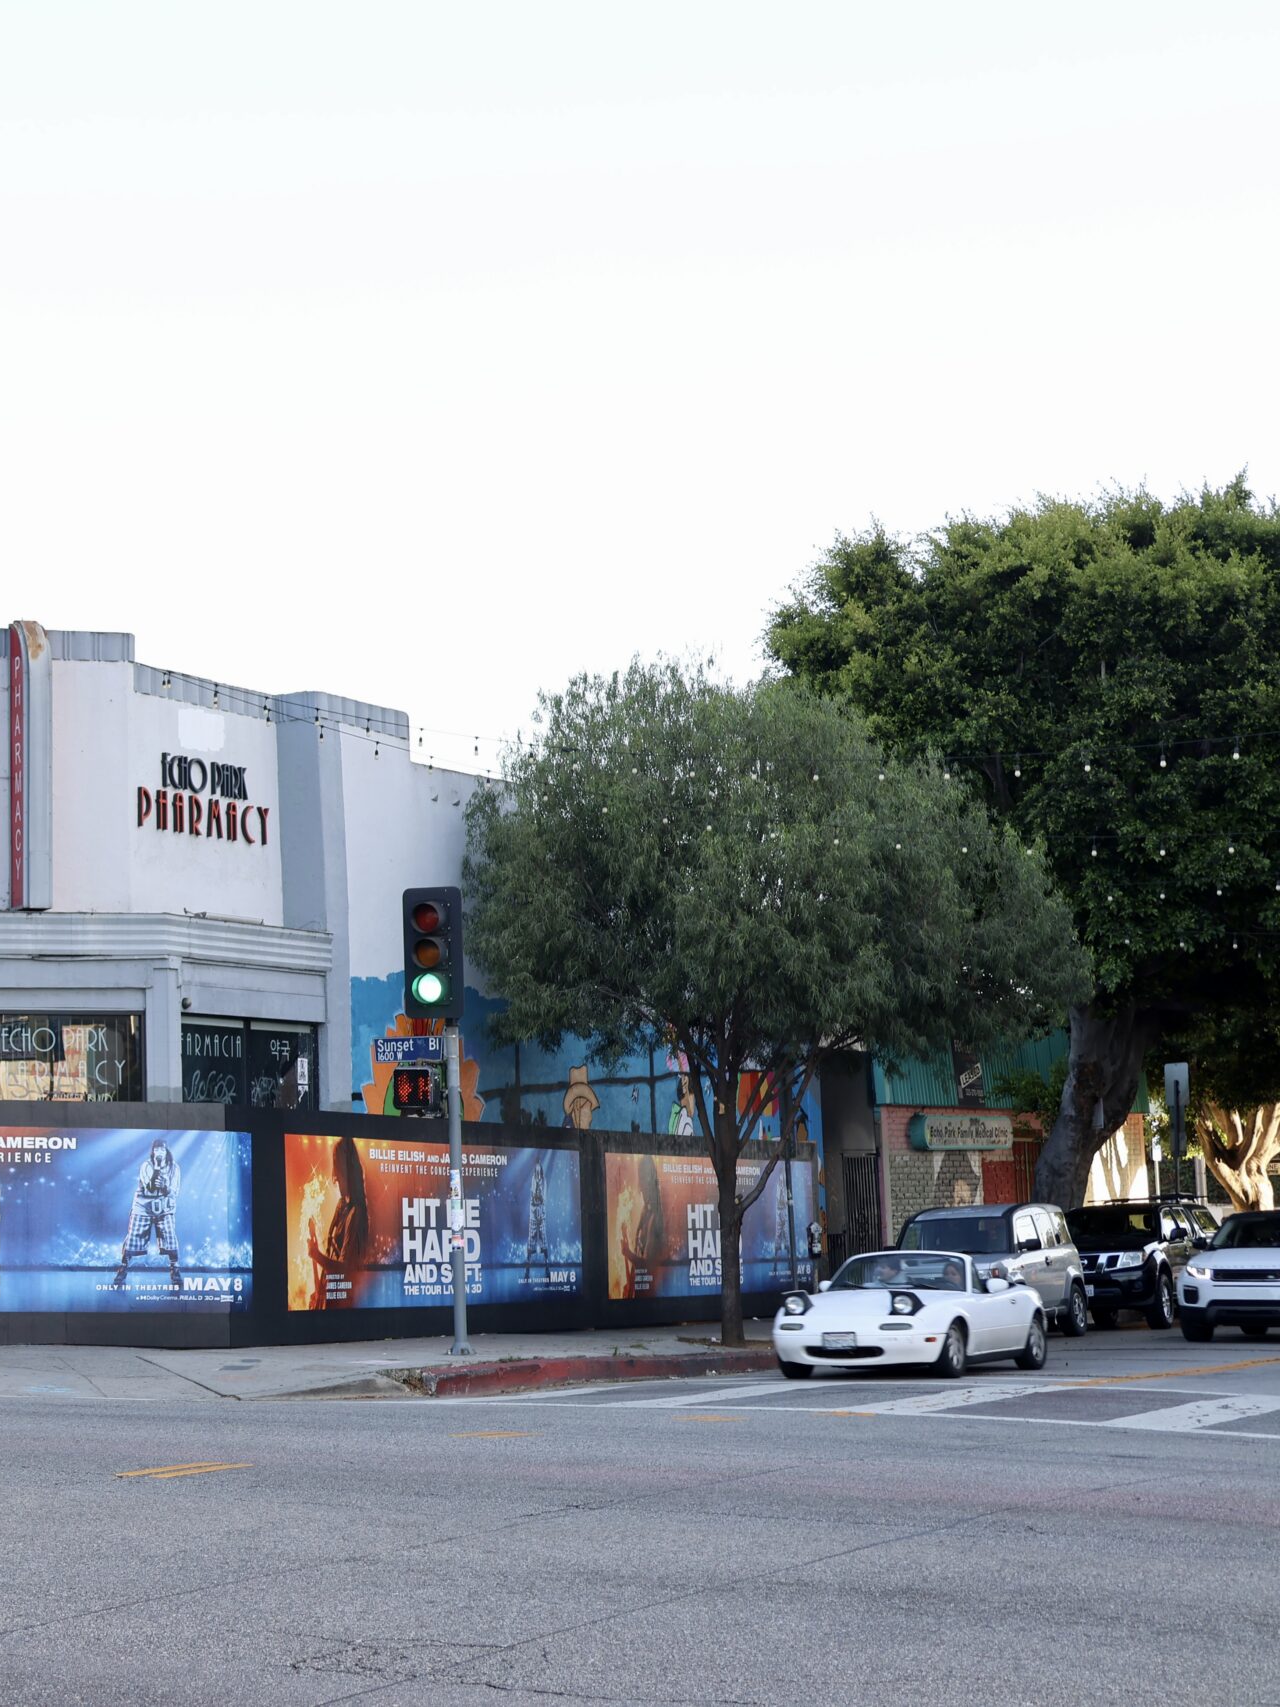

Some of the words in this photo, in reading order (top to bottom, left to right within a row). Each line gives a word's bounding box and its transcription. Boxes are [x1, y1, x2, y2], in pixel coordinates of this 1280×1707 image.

[14, 656, 22, 880] PHARMACY
[160, 752, 208, 794] ECHO
[210, 761, 249, 801] PARK
[137, 786, 270, 846] PHARMACY
[1, 1027, 56, 1052] ECHO
[63, 1027, 109, 1052] PARK
[377, 1038, 414, 1052] Sunset
[428, 1037, 439, 1051] Bl
[377, 1052, 395, 1061] 1600
[396, 1051, 403, 1060] W
[930, 1125, 943, 1138] Echo
[944, 1125, 956, 1138] Park
[957, 1126, 973, 1139] Family
[975, 1125, 993, 1138] Medical
[994, 1126, 1008, 1138] Clinic
[369, 1148, 396, 1160] BILLIE
[398, 1150, 425, 1162] EILISH
[427, 1155, 439, 1163] AND
[440, 1154, 468, 1164] JAS
[469, 1154, 508, 1165] CAMERON
[380, 1163, 413, 1174] REINVENT
[416, 1165, 427, 1175] THE
[431, 1166, 450, 1176] CONCE
[461, 1167, 498, 1177] EXPERIENCE
[683, 1164, 703, 1174] EILISH
[402, 1197, 440, 1228] HIT
[687, 1204, 715, 1229] HIT
[403, 1263, 438, 1284] AND
[440, 1263, 482, 1284] SFT:
[689, 1259, 713, 1276] AND
[806, 1264, 811, 1275] 8
[183, 1277, 232, 1291] MAY
[233, 1278, 243, 1291] 8
[550, 1271, 568, 1283] MAY
[570, 1270, 577, 1283] 8
[689, 1277, 701, 1287] THE
[403, 1285, 419, 1295] THE
[420, 1284, 442, 1295] TOUR
[471, 1283, 482, 1293] 3D
